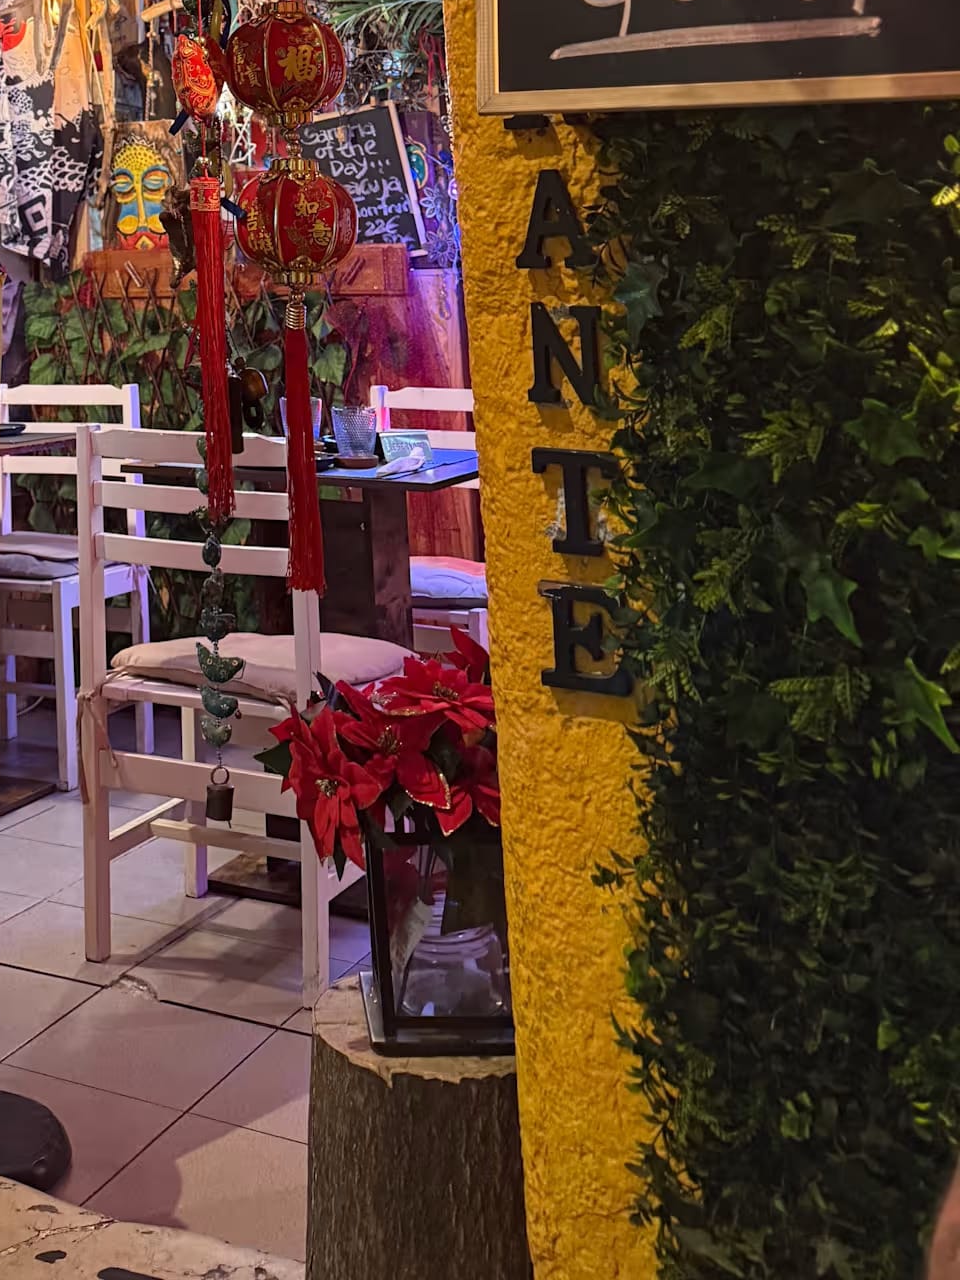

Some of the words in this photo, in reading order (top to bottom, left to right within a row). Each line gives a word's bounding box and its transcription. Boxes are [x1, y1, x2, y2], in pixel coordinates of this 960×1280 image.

[278, 45, 317, 82] 福
[315, 141, 335, 160] of
[336, 139, 378, 158] the
